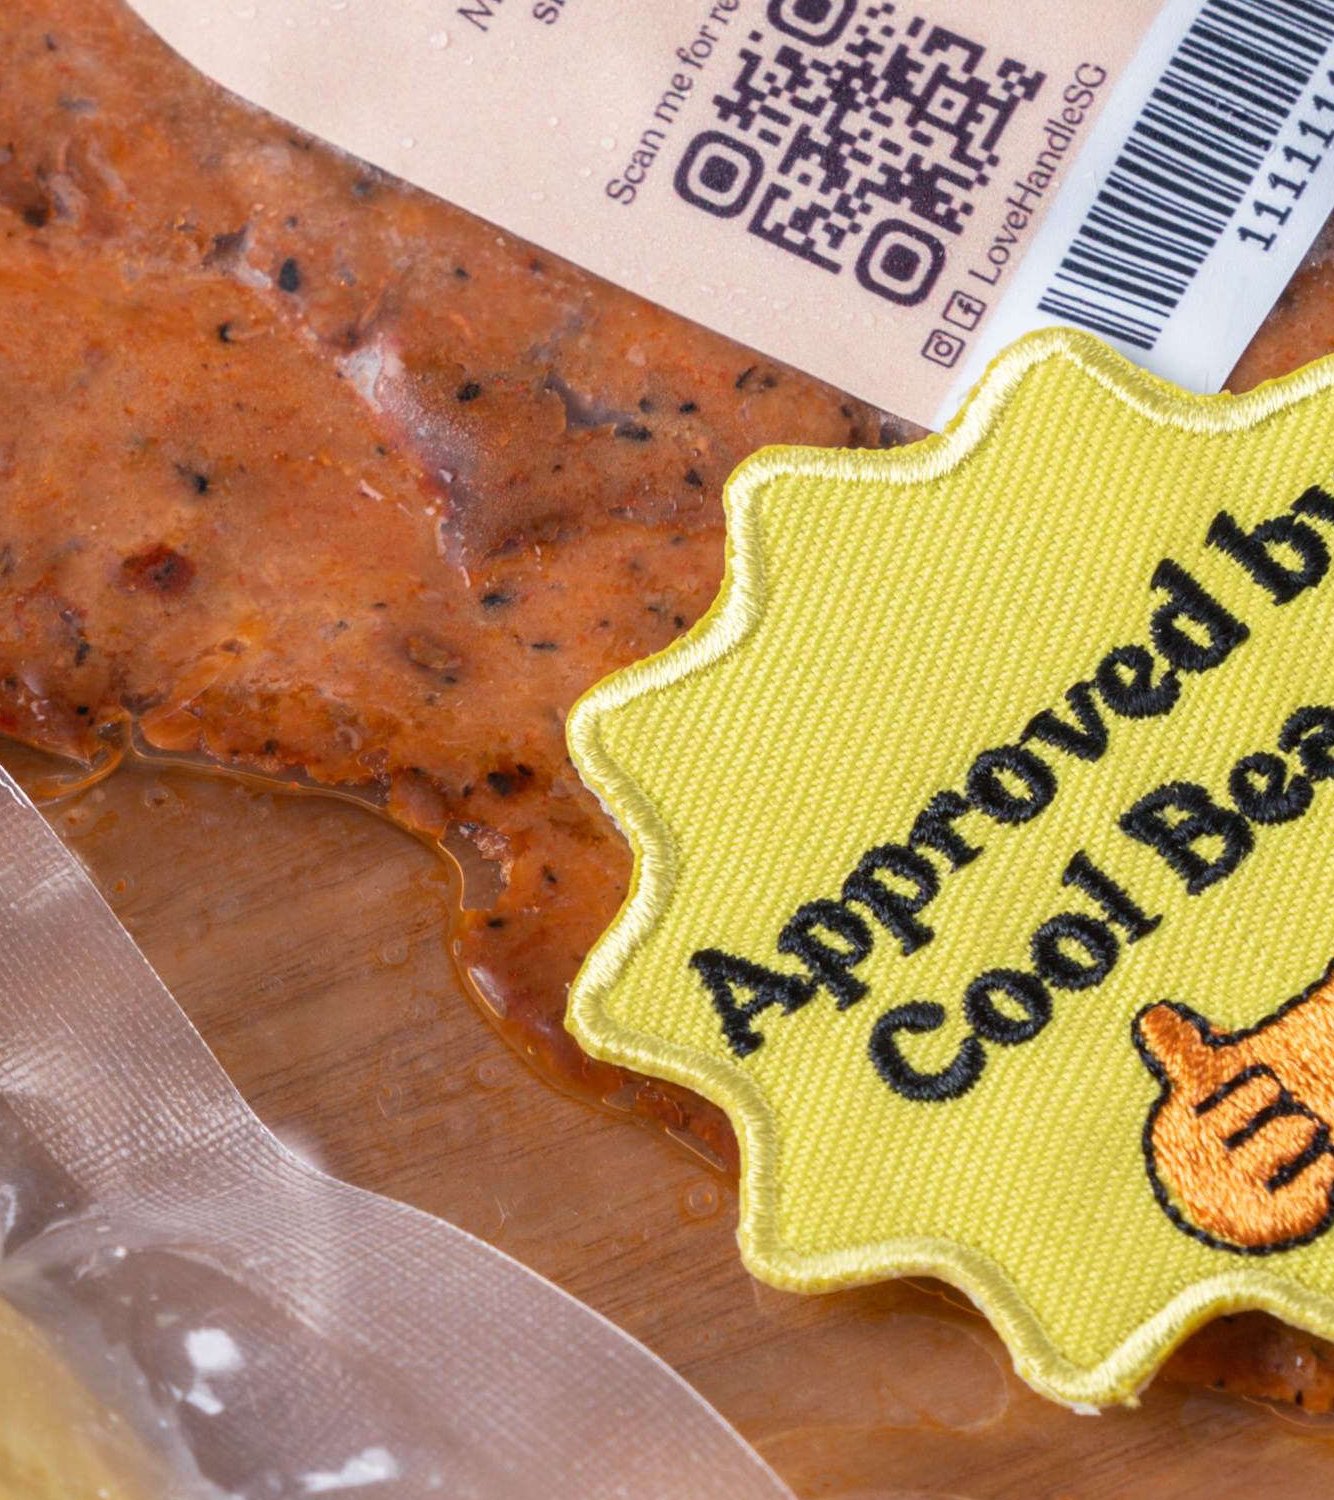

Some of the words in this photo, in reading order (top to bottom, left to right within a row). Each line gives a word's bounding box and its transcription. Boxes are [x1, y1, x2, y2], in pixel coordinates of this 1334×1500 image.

[605, 121, 666, 206] Scan
[652, 66, 694, 122] me
[679, 17, 722, 73] for
[968, 62, 1107, 287] LoveHandleSG
[687, 559, 1249, 1057] Approved
[867, 850, 1162, 1103] Cool
